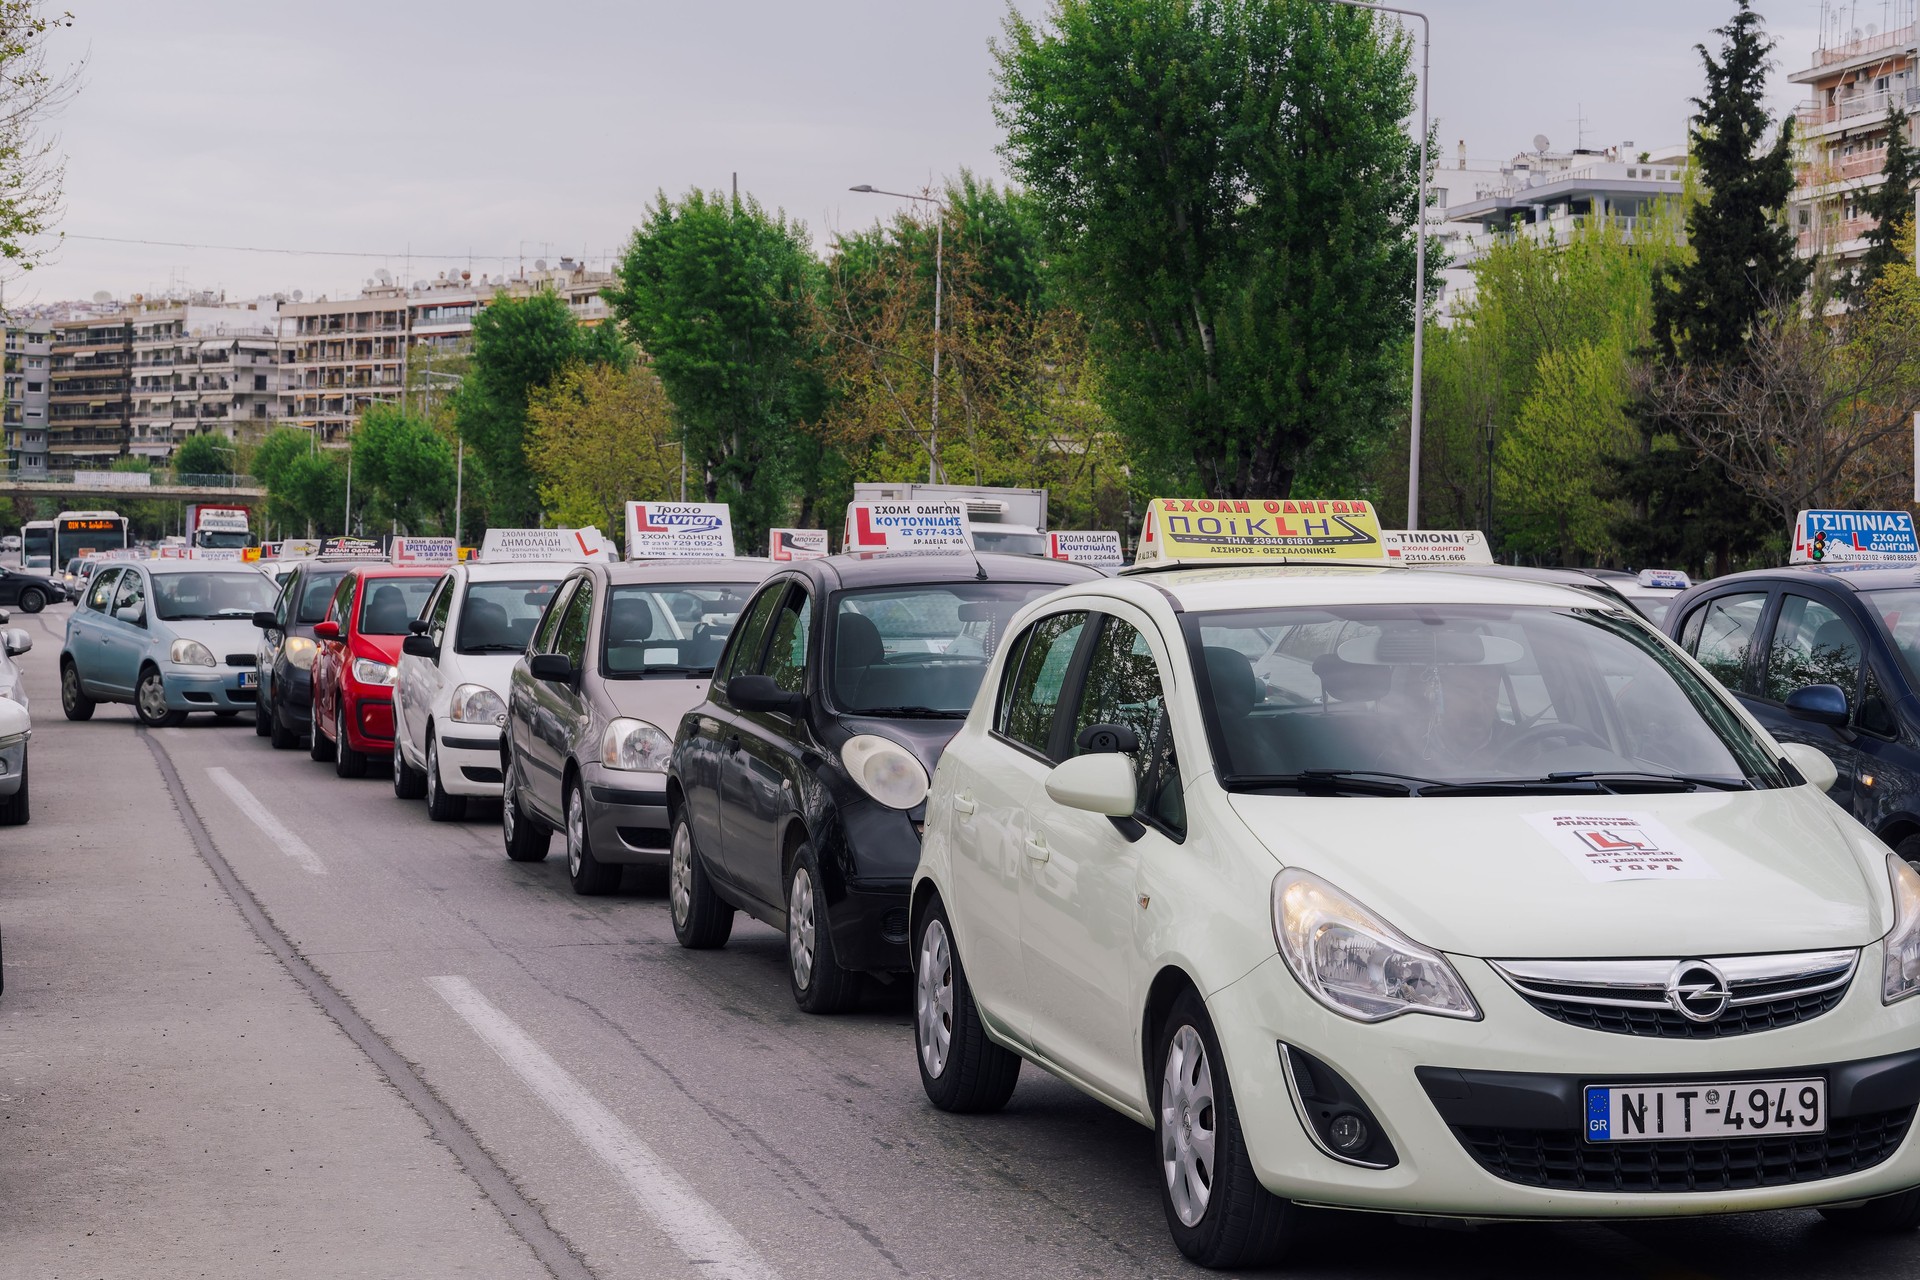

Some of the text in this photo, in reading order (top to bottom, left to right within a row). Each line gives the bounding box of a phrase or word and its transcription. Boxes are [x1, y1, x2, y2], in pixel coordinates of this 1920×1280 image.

[874, 505, 960, 515] ΣΧΟΛΗ ΟΔΗΓΩΝ
[1162, 500, 1367, 514] ΣΧΟΛΗ ΟΔΗΓΩΝ
[875, 516, 961, 527] ΚΟΥΤΟΥΝΙΔΗΣ
[1808, 514, 1911, 532] ΤΣΙΠΙΝΙΑΣ
[916, 528, 962, 536] 677-433
[1059, 535, 1117, 543] ΣΧΟΛΗ ΟΔΗΓΩΝ
[1226, 537, 1314, 545] ΤΗΛ. 23940 61810
[1872, 533, 1910, 542] ΣΧΟΛΗ
[1060, 543, 1117, 554] Κουτσιώλης
[1263, 547, 1336, 555] ΘΕΣΣΑΛΟΝΙΚΗΣ
[1869, 542, 1915, 551] ΟΔΗΓΩΝ
[1609, 864, 1680, 872] ΤΩΡΑ
[1621, 1086, 1819, 1134] NIT-4949
[1589, 1120, 1608, 1131] GR
